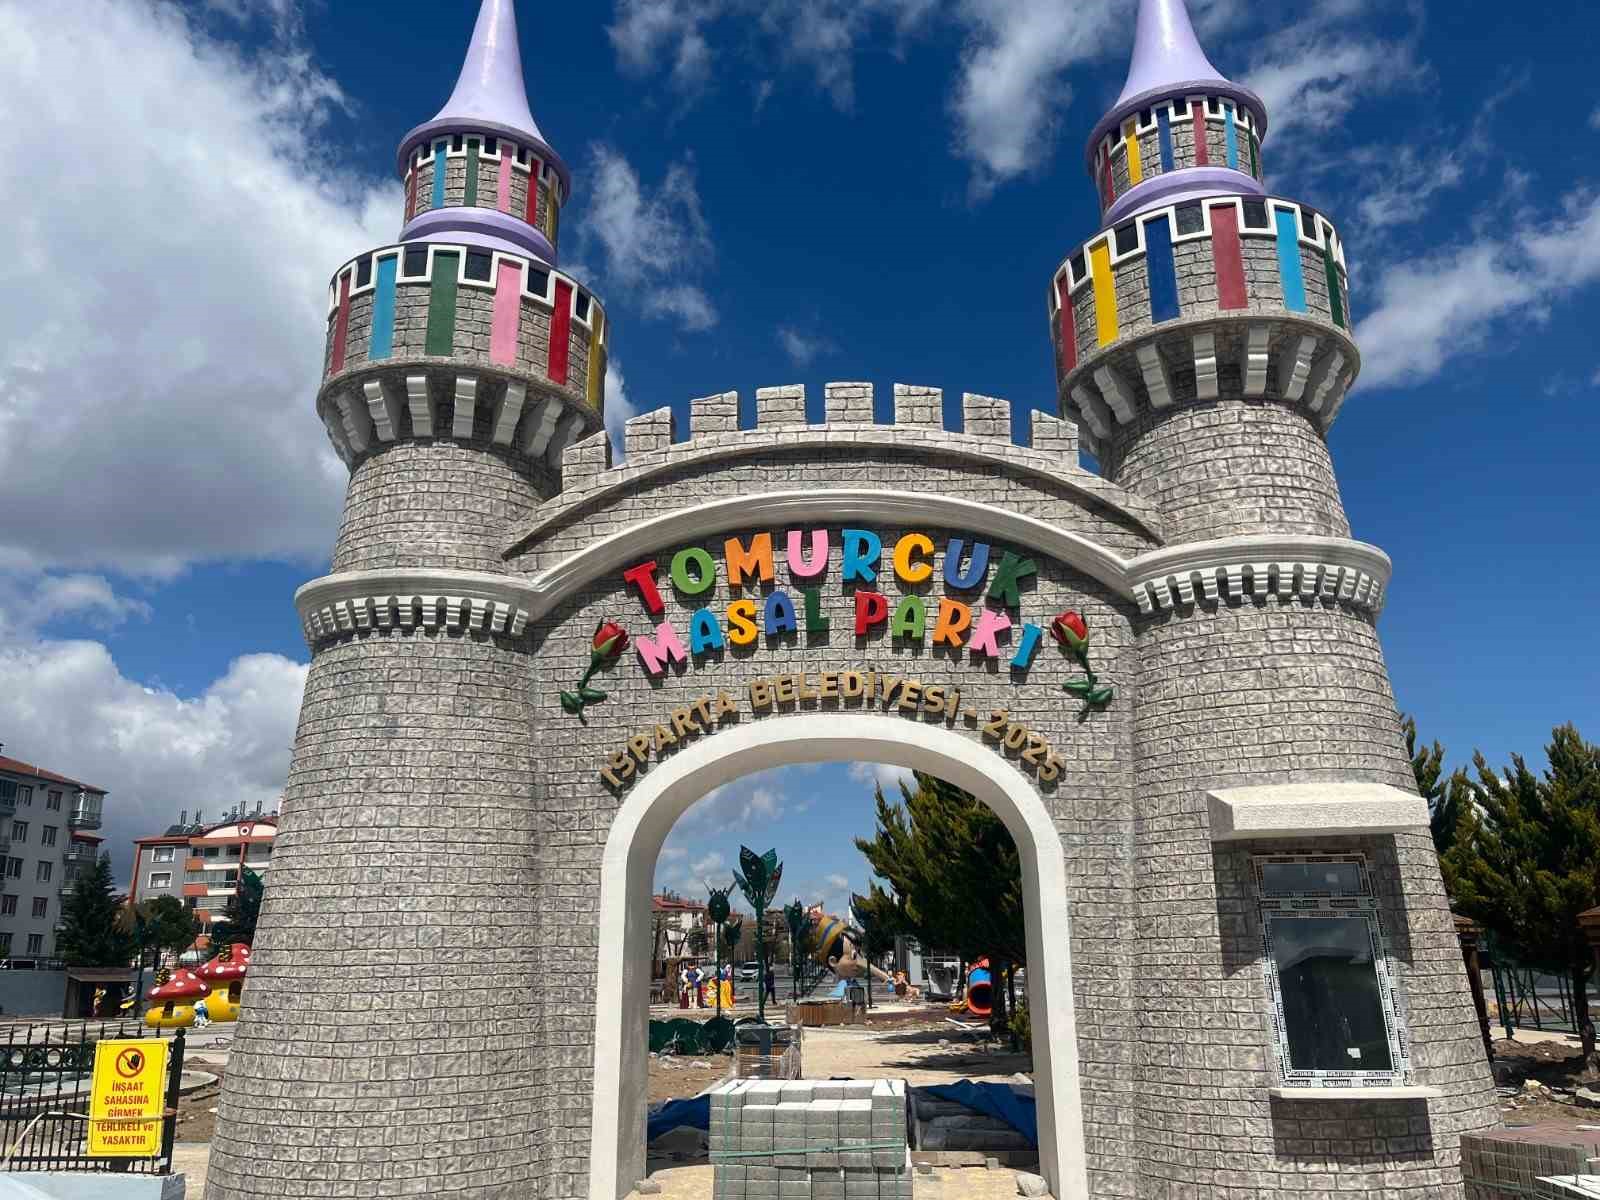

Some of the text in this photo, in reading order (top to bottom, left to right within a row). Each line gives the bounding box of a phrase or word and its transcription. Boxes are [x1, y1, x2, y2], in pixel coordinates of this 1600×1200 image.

[624, 529, 1038, 614] TOMURCUK
[635, 588, 1042, 675] MASAL PARKI
[600, 692, 737, 787] ISPARTA
[751, 666, 961, 719] BELEDİYESİ
[982, 708, 1065, 782] 2025
[112, 1080, 144, 1094] İNŞAAT
[104, 1095, 149, 1105] SAHASINA
[144, 1124, 154, 1132] ve
[102, 1135, 146, 1145] YASAKTIR
